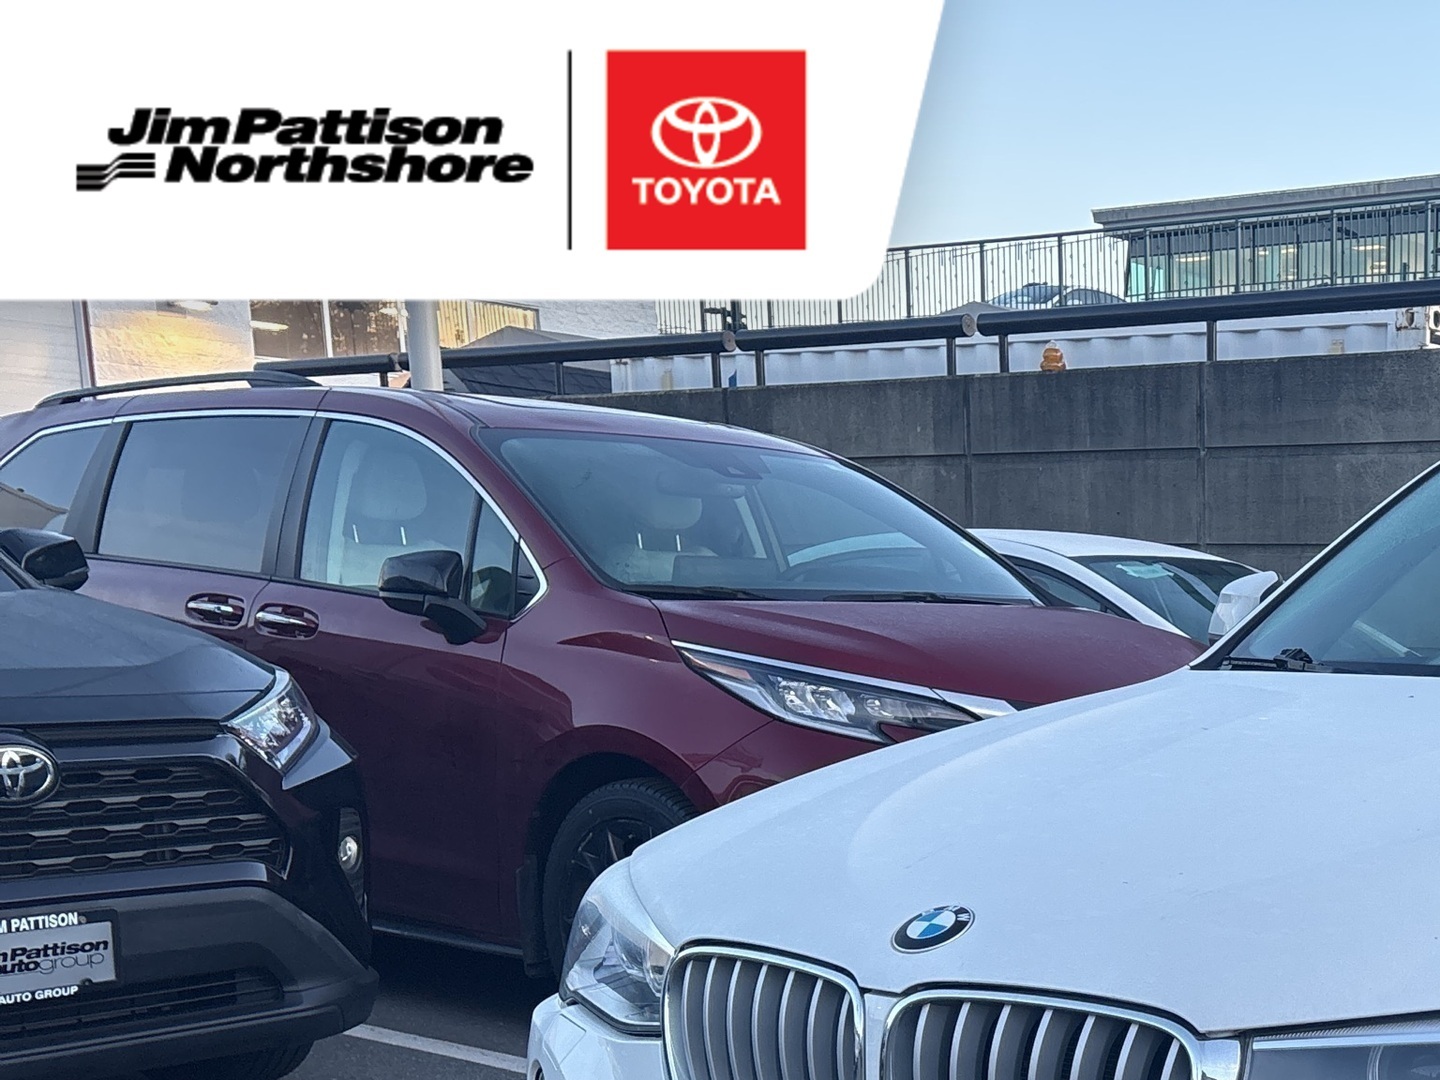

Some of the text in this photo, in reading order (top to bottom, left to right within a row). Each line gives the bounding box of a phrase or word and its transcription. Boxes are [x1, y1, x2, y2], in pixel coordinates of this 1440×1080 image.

[10, 911, 78, 932] PATTISON
[10, 939, 109, 962] Pattison
[0, 953, 104, 975] utogroup
[34, 985, 79, 1000] GROUP
